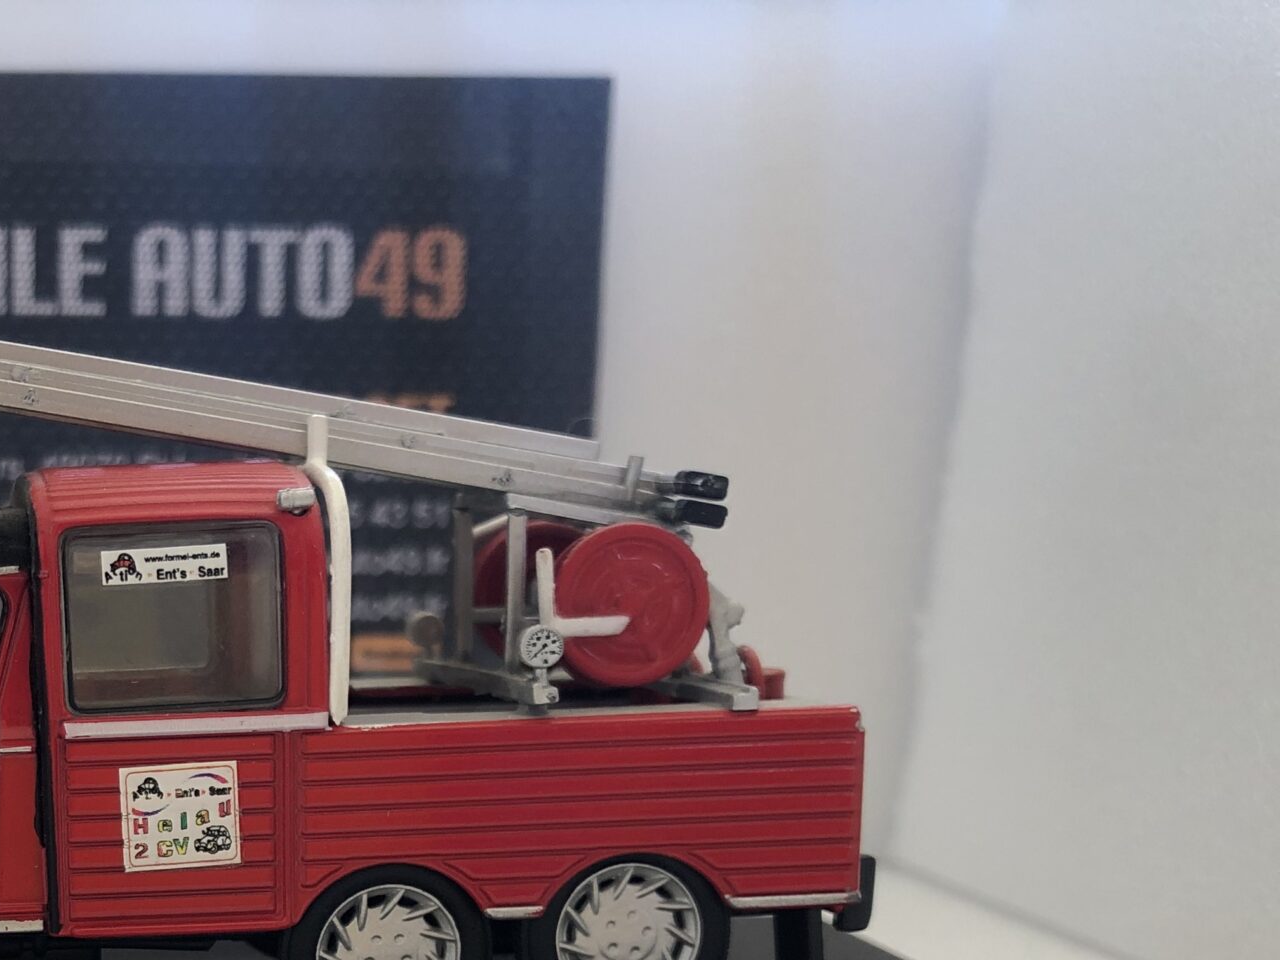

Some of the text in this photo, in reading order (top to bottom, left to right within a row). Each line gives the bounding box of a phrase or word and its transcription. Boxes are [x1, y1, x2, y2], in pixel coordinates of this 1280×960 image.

[156, 568, 188, 580] Ent's
[198, 566, 225, 578] Saar
[134, 836, 190, 859] 2 CV
